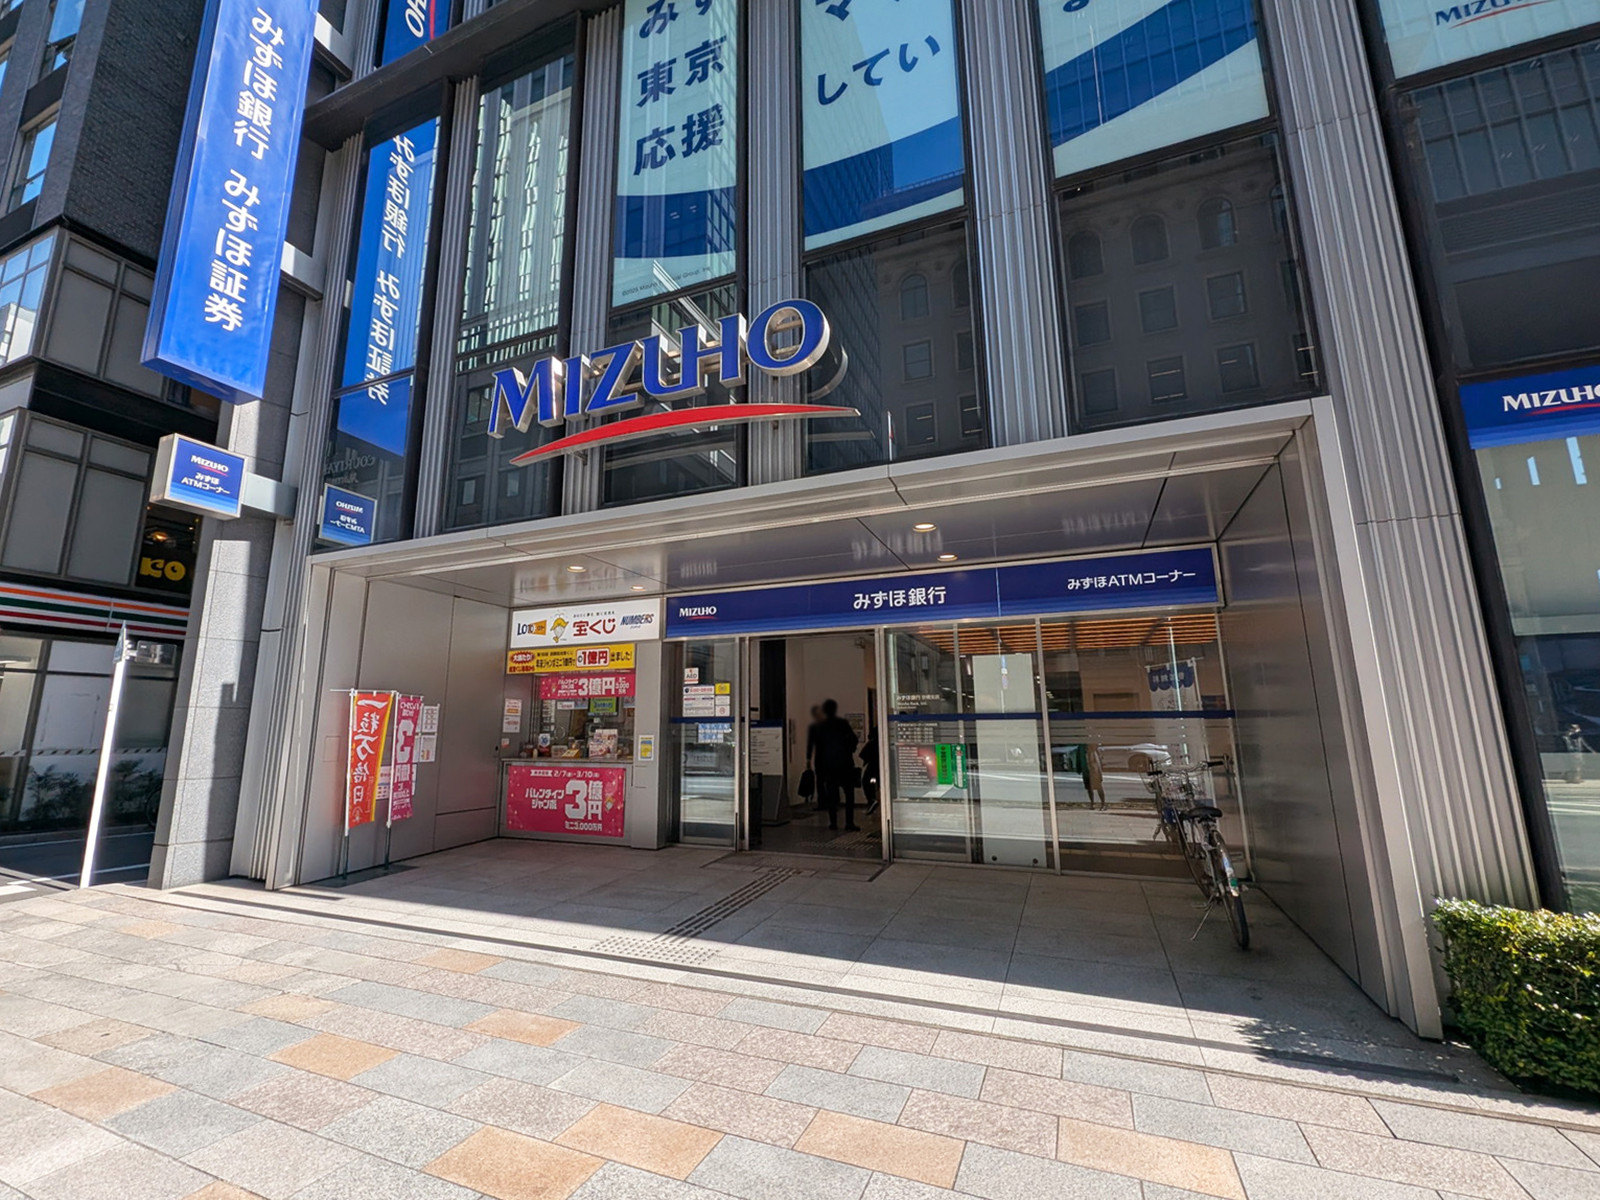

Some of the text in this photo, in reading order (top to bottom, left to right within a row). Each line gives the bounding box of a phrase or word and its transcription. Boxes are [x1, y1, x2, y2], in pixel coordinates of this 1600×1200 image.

[636, 35, 727, 108] 東京
[817, 35, 941, 106] してい
[633, 103, 725, 176] 応援
[205, 7, 284, 332] みずほ銀行 みずほ証券
[487, 298, 831, 439] MIZUHO
[190, 455, 229, 473] MIZUHO
[181, 476, 231, 495] ATMコーナー
[195, 472, 220, 484] みずほ
[1067, 571, 1196, 591] みずほATMコーナー
[853, 586, 946, 610] みずほ銀行
[620, 613, 655, 626] NUMBERS
[679, 606, 717, 617] MIZUHO
[572, 618, 616, 637] 宝くじ
[578, 677, 616, 696] 3億円
[525, 787, 565, 800] バレンタイン
[531, 798, 558, 810] ジャンボ
